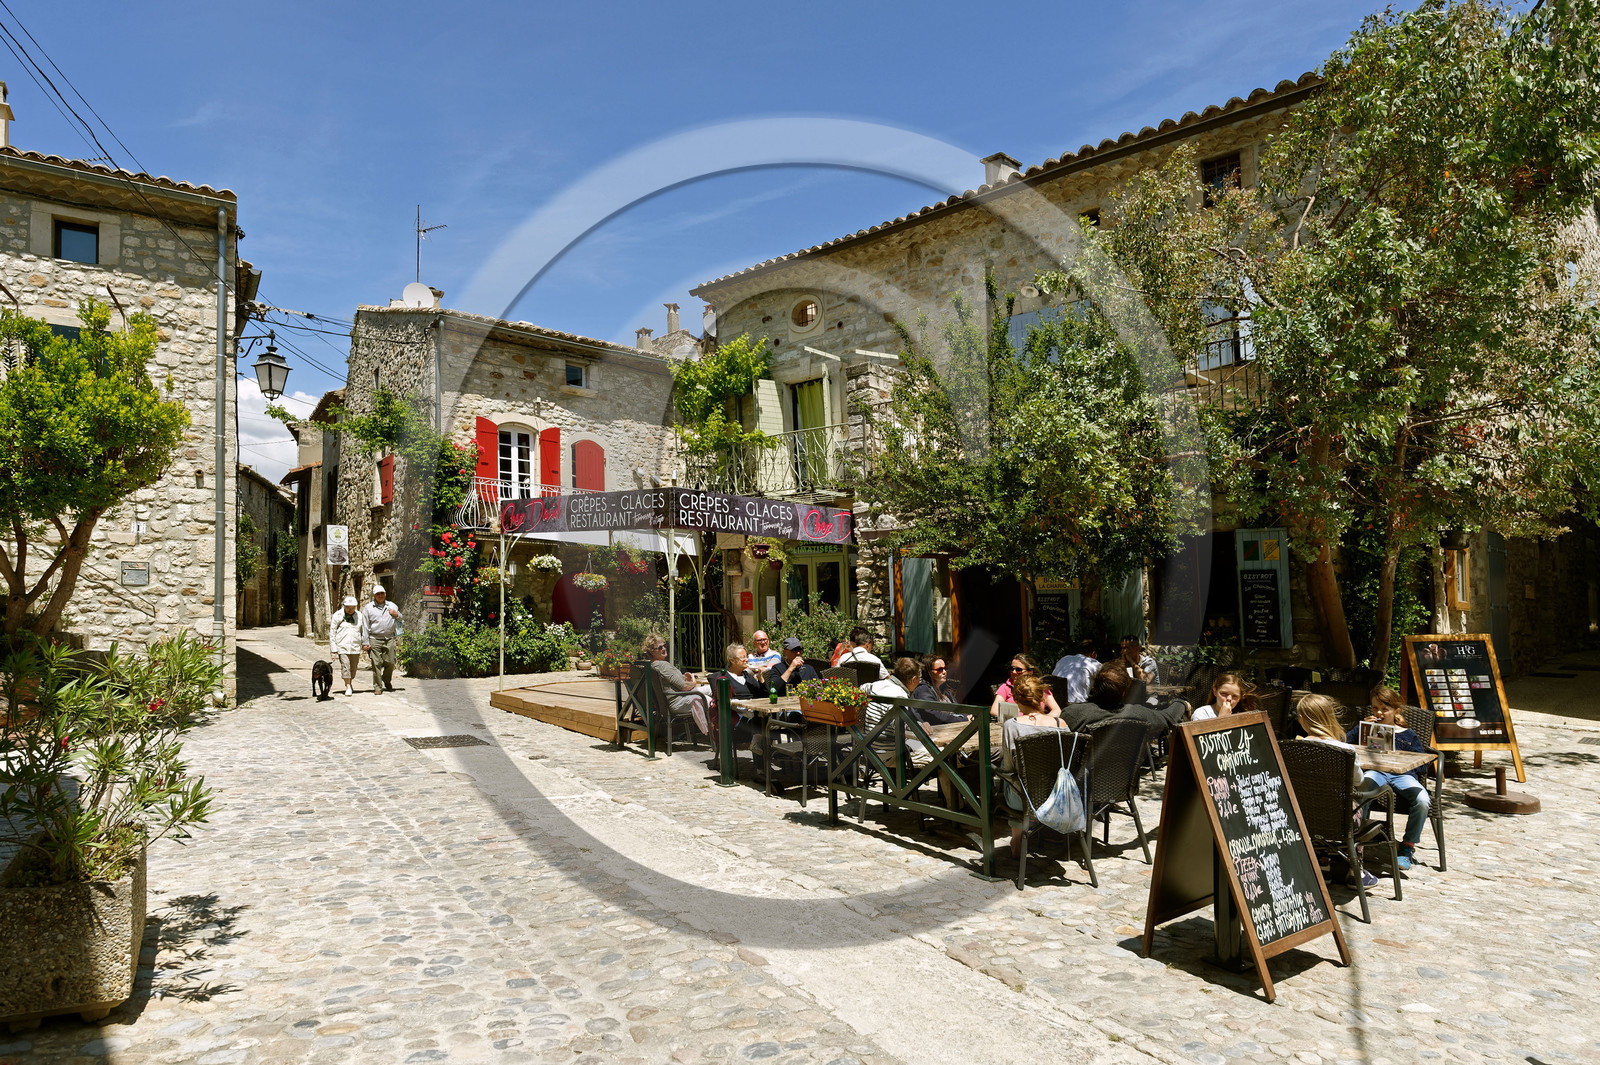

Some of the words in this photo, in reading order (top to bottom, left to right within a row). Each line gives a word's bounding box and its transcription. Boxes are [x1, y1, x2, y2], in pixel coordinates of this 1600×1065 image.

[571, 496, 608, 513] CRÊPES
[620, 492, 665, 510] GLACES
[679, 492, 730, 512] CRÊPES
[745, 501, 793, 521] GLACES
[570, 511, 633, 529] RESTAURANT
[679, 510, 759, 532] RESTAURANT
[803, 509, 835, 539] Chez
